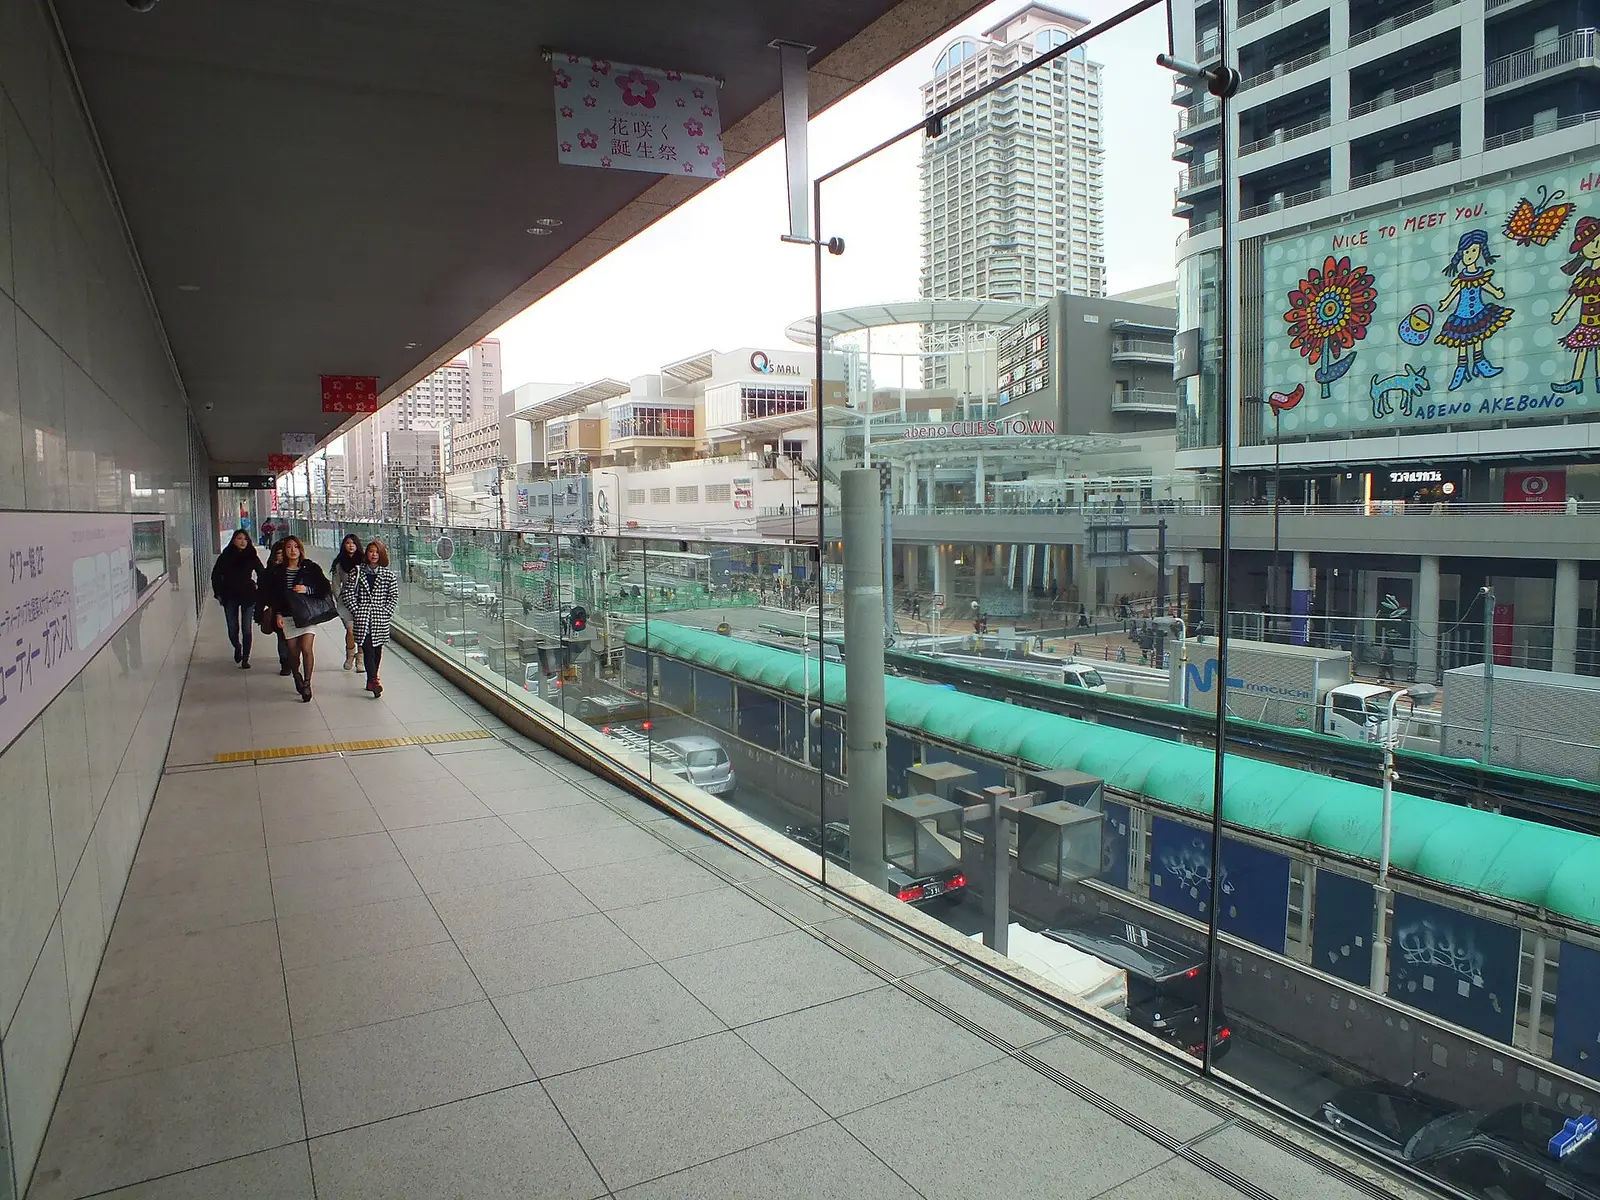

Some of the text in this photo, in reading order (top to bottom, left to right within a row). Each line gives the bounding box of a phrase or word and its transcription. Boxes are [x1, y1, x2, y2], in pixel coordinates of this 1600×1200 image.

[609, 117, 668, 140] 花咲く
[611, 138, 677, 161] 誕生祭
[1332, 203, 1488, 251] NICE TO MEET YOU.
[776, 364, 801, 375] MALL
[1415, 393, 1565, 420] ABENO AKEBONO
[903, 420, 1055, 440] abeno CUES TOWN
